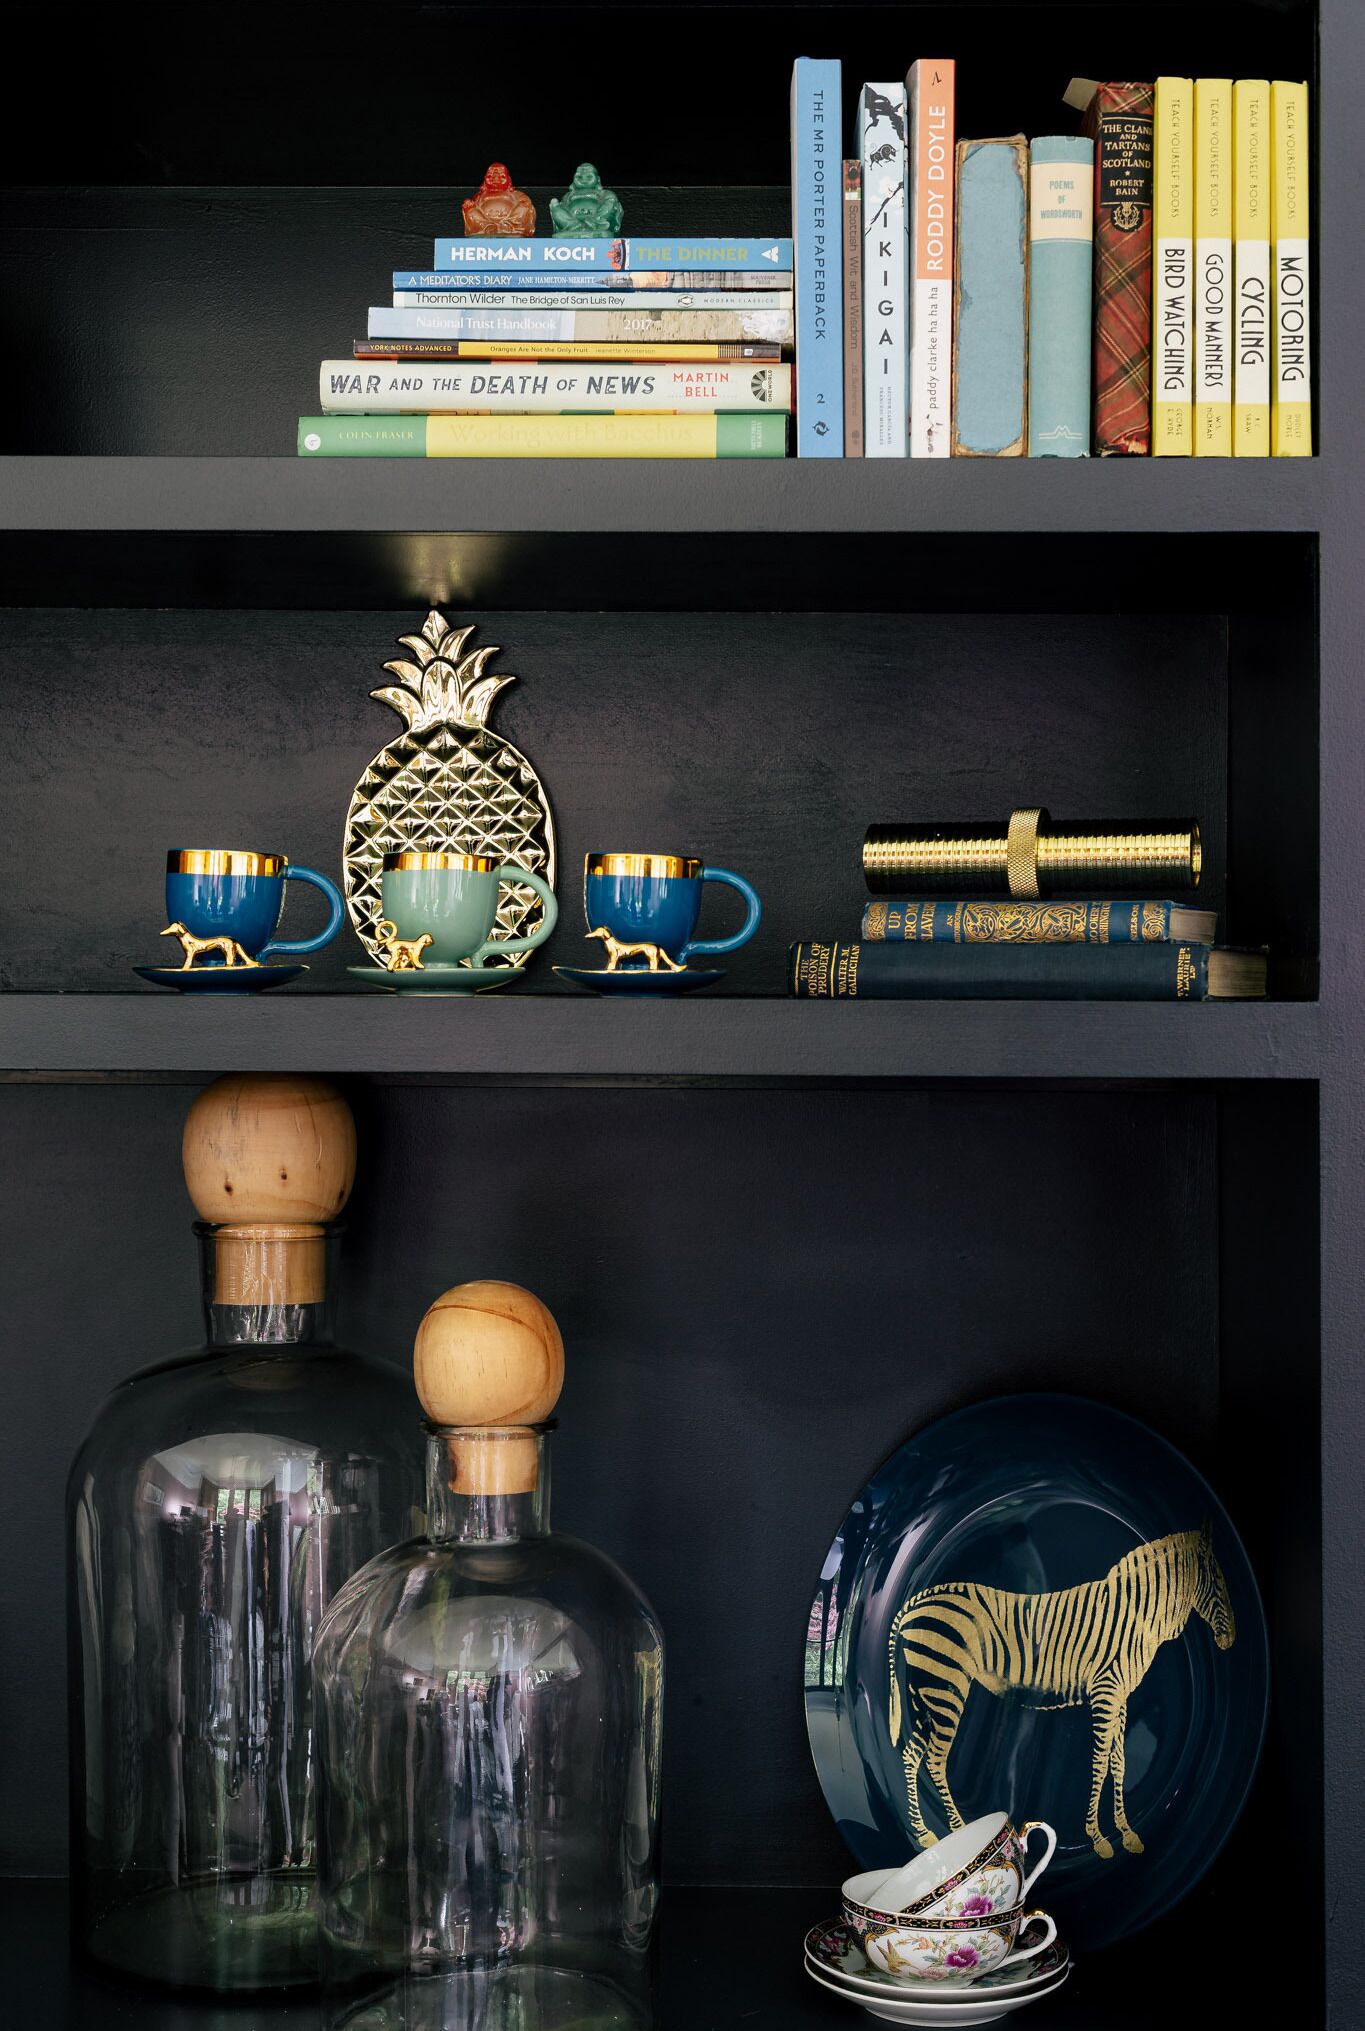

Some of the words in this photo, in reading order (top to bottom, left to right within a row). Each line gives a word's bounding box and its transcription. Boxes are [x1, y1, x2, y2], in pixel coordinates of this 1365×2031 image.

[813, 90, 824, 123] THE
[1171, 99, 1181, 128] TEACH
[1210, 98, 1219, 127] TEACH
[1249, 99, 1259, 128] TEACH
[1286, 101, 1296, 129] TEACH
[813, 129, 824, 153] MR
[927, 105, 946, 181] DOYLE
[1102, 124, 1122, 134] THE
[1124, 124, 1152, 135] CLANS
[1105, 141, 1151, 151] TARTANS
[1171, 131, 1181, 179] YOURSELF
[1210, 130, 1219, 179] YOURSELF
[1249, 131, 1259, 179] YOURSELF
[1286, 132, 1296, 181] YOURSELF
[1102, 159, 1151, 169] SCOTLAND
[814, 159, 825, 229] PORTER
[1049, 180, 1075, 191] POEMS
[1109, 179, 1145, 187] ROBERT
[1115, 187, 1138, 196] BAIN
[1057, 195, 1066, 204] OF
[1171, 184, 1181, 218] BOOKS
[1210, 183, 1219, 217] BOOKS
[1249, 184, 1259, 218] BOOKS
[1286, 186, 1296, 219] BOOKS
[849, 205, 859, 251] Scottish
[1040, 209, 1083, 220] WORDSWORTH
[927, 190, 945, 270] RODDY
[450, 246, 532, 262] HERMAN
[543, 246, 595, 262] KOCH
[636, 247, 672, 262] THE
[678, 247, 749, 262] DINNER
[849, 256, 859, 277] Wit
[408, 276, 417, 286] A
[420, 275, 481, 286] MEDITATOR'S
[483, 275, 513, 286] DIARY
[517, 276, 534, 285] JANE
[1164, 248, 1185, 289] BIRD
[814, 236, 826, 340] PAPERBACK
[849, 281, 859, 300] and
[928, 287, 938, 300] ha
[1205, 253, 1224, 315] GOOD
[416, 292, 468, 304] Thornton
[470, 292, 505, 304] Wilder
[511, 295, 528, 304] The
[529, 295, 558, 306] Bridge
[559, 295, 570, 305] of
[570, 296, 588, 305] San
[590, 296, 606, 305] Luis
[608, 296, 625, 307] Rey
[928, 303, 938, 316] ha
[416, 317, 464, 330] National
[465, 317, 495, 330] Trust
[498, 317, 557, 331] Handbook
[623, 319, 653, 331] 2017
[849, 305, 859, 349] Wisdom
[928, 320, 938, 333] ha
[1240, 277, 1265, 365] CYCLING
[1280, 257, 1305, 382] MOTORING
[390, 344, 413, 352] NOTES
[414, 344, 452, 352] ADVANCED
[490, 345, 517, 353] Oranges
[556, 346, 572, 355] Only
[927, 337, 939, 372] clarke
[1164, 295, 1185, 390] WATCHING
[1205, 321, 1224, 388] MANNERS
[330, 374, 382, 395] WAR
[389, 377, 424, 391] AND
[433, 378, 462, 391] THE
[469, 375, 549, 395] DEATH
[556, 378, 578, 391] OF
[586, 375, 656, 395] NEWS
[673, 372, 729, 383] MARTIN
[685, 386, 718, 397] BELL
[816, 393, 825, 404] 2
[928, 375, 941, 409] paddy
[337, 431, 373, 440] COLIN
[375, 431, 415, 440] FRASER
[451, 423, 541, 449] Working
[546, 422, 598, 441] with
[604, 422, 693, 442] Bacchus
[888, 911, 901, 929] UP
[904, 903, 920, 940] FROM
[946, 915, 953, 927] AN
[811, 942, 821, 957] OF
[800, 959, 810, 981] THE
[808, 958, 819, 997] POISON
[817, 946, 831, 995] PRUDERY
[838, 958, 849, 995] WALTER
[848, 944, 861, 996] GALLICHAN
[1183, 953, 1191, 991] LAURIE
